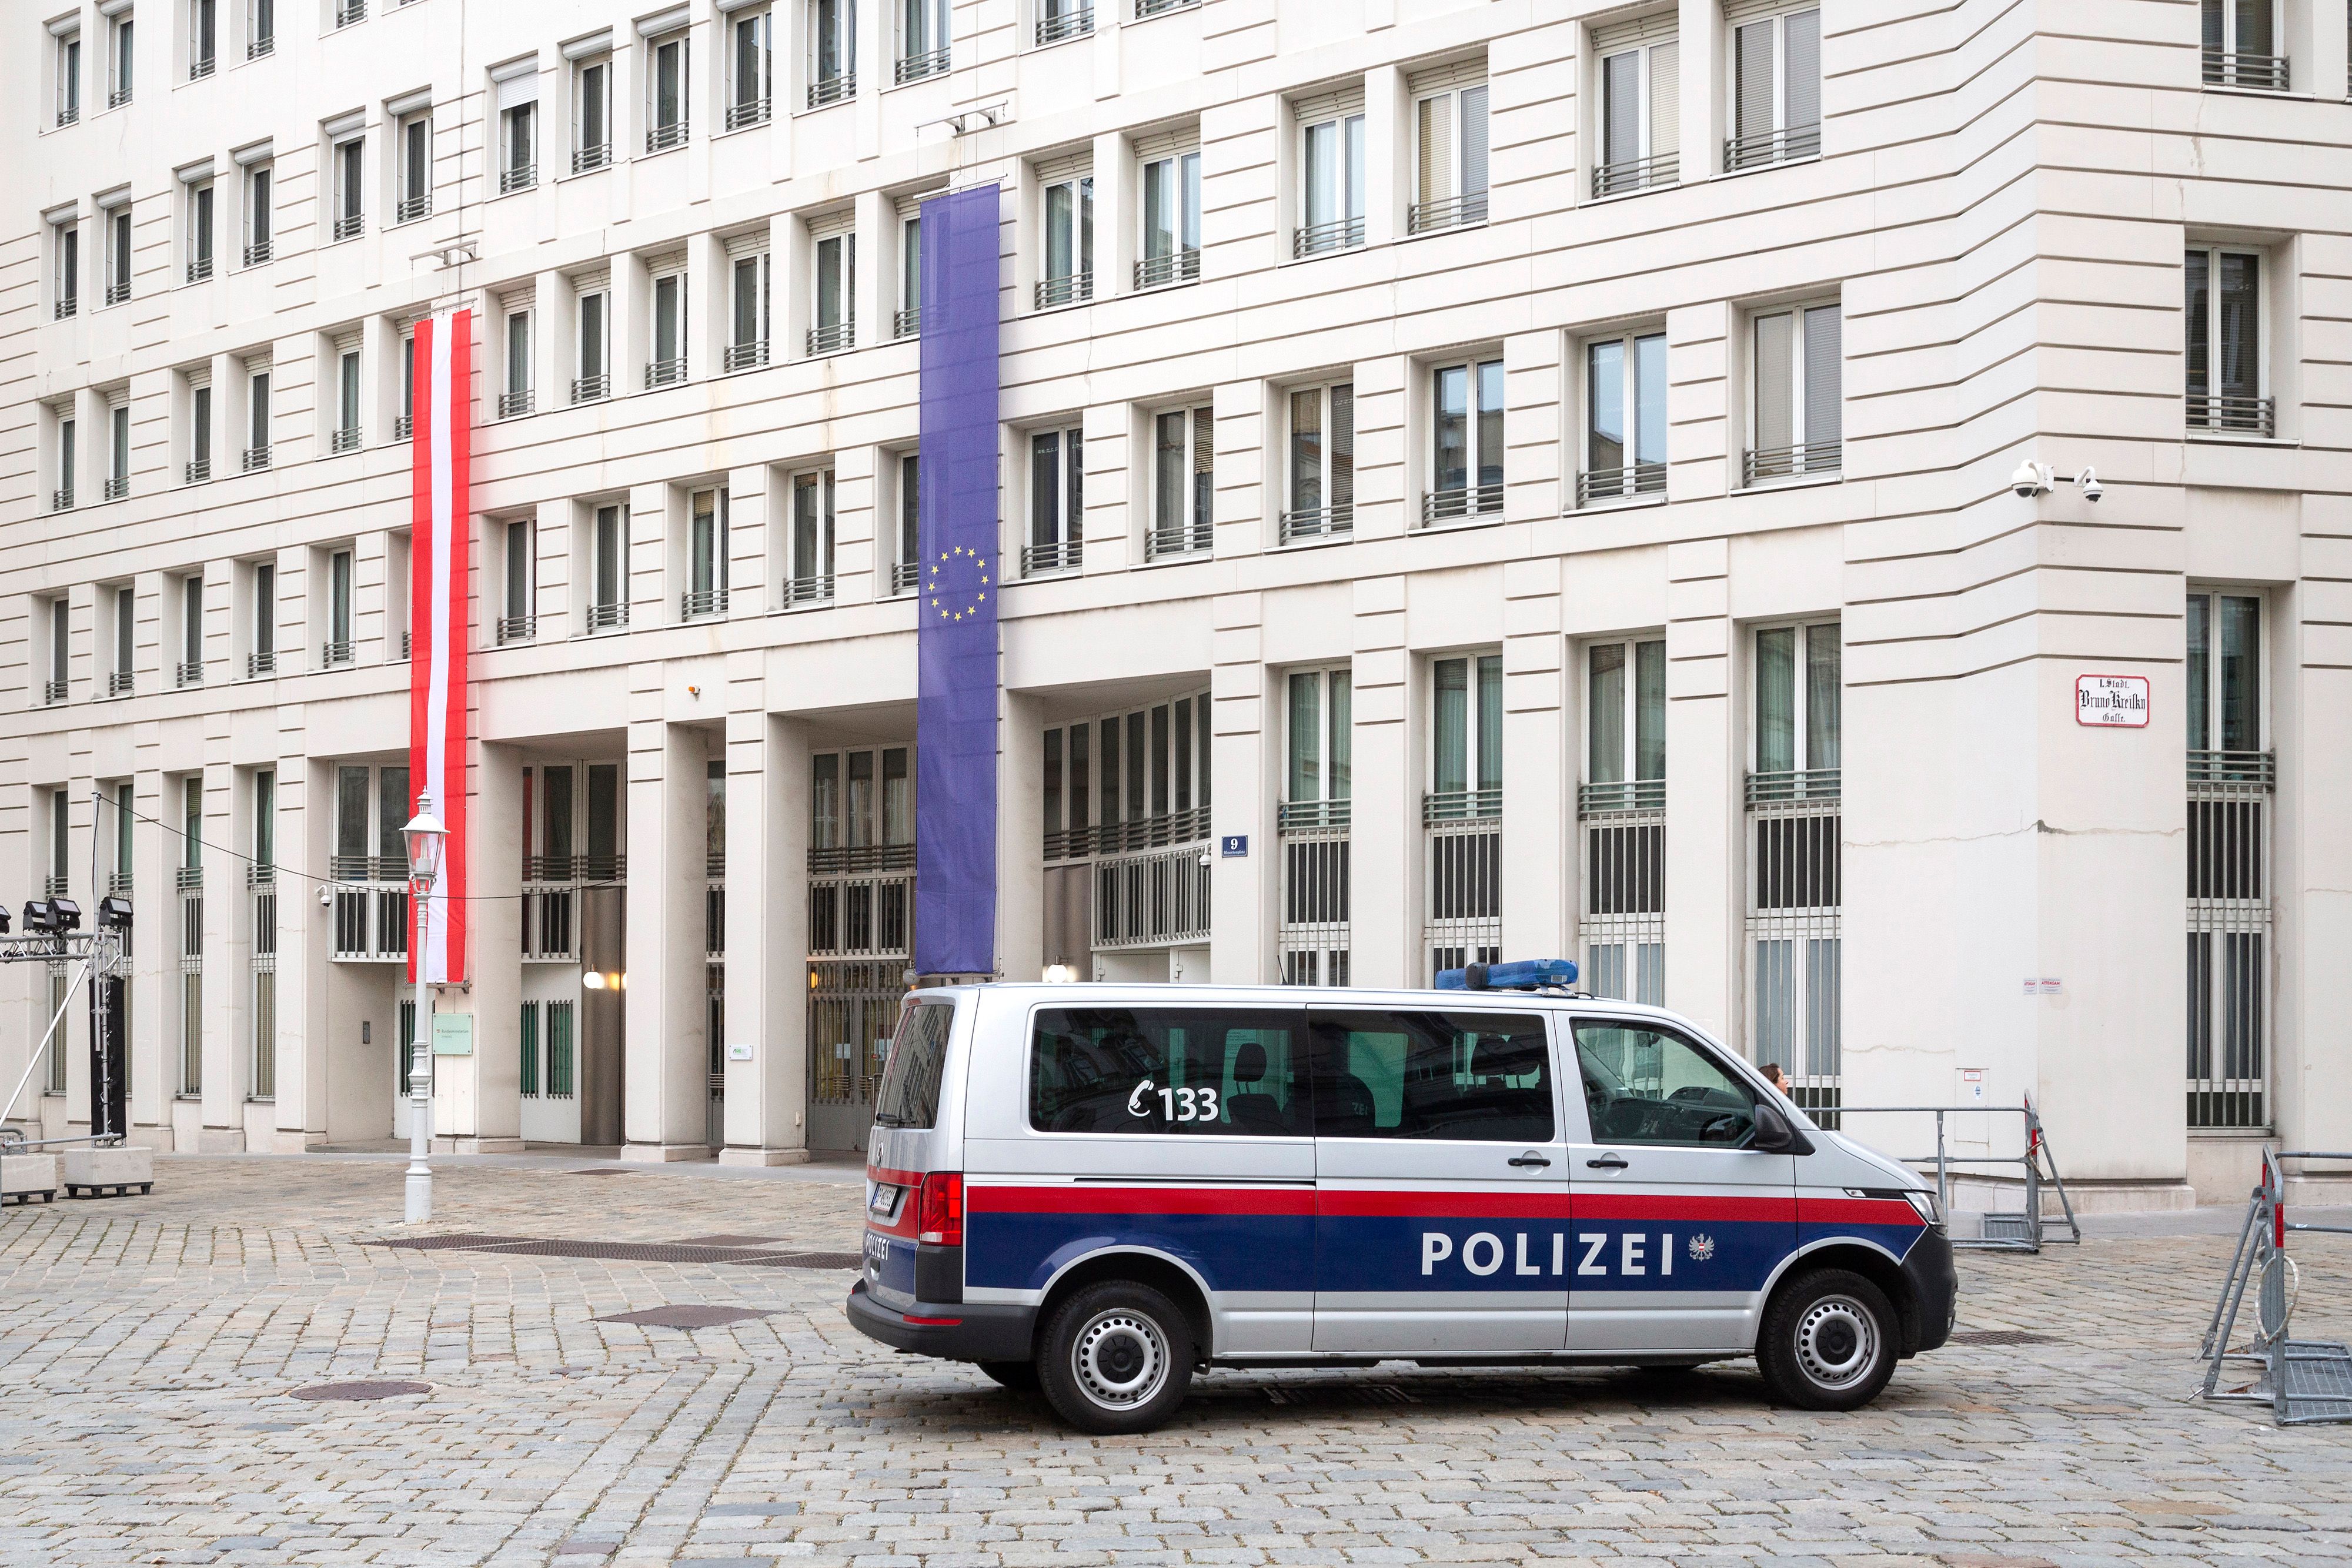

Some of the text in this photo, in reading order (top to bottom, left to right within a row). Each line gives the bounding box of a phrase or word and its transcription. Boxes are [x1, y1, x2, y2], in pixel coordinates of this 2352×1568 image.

[2079, 690, 2110, 710] Bruno
[1230, 838, 1238, 850] 9
[1158, 1087, 1218, 1121] 133
[866, 1233, 890, 1261] POLIZEI
[1422, 1232, 1673, 1276] POLIZEI
